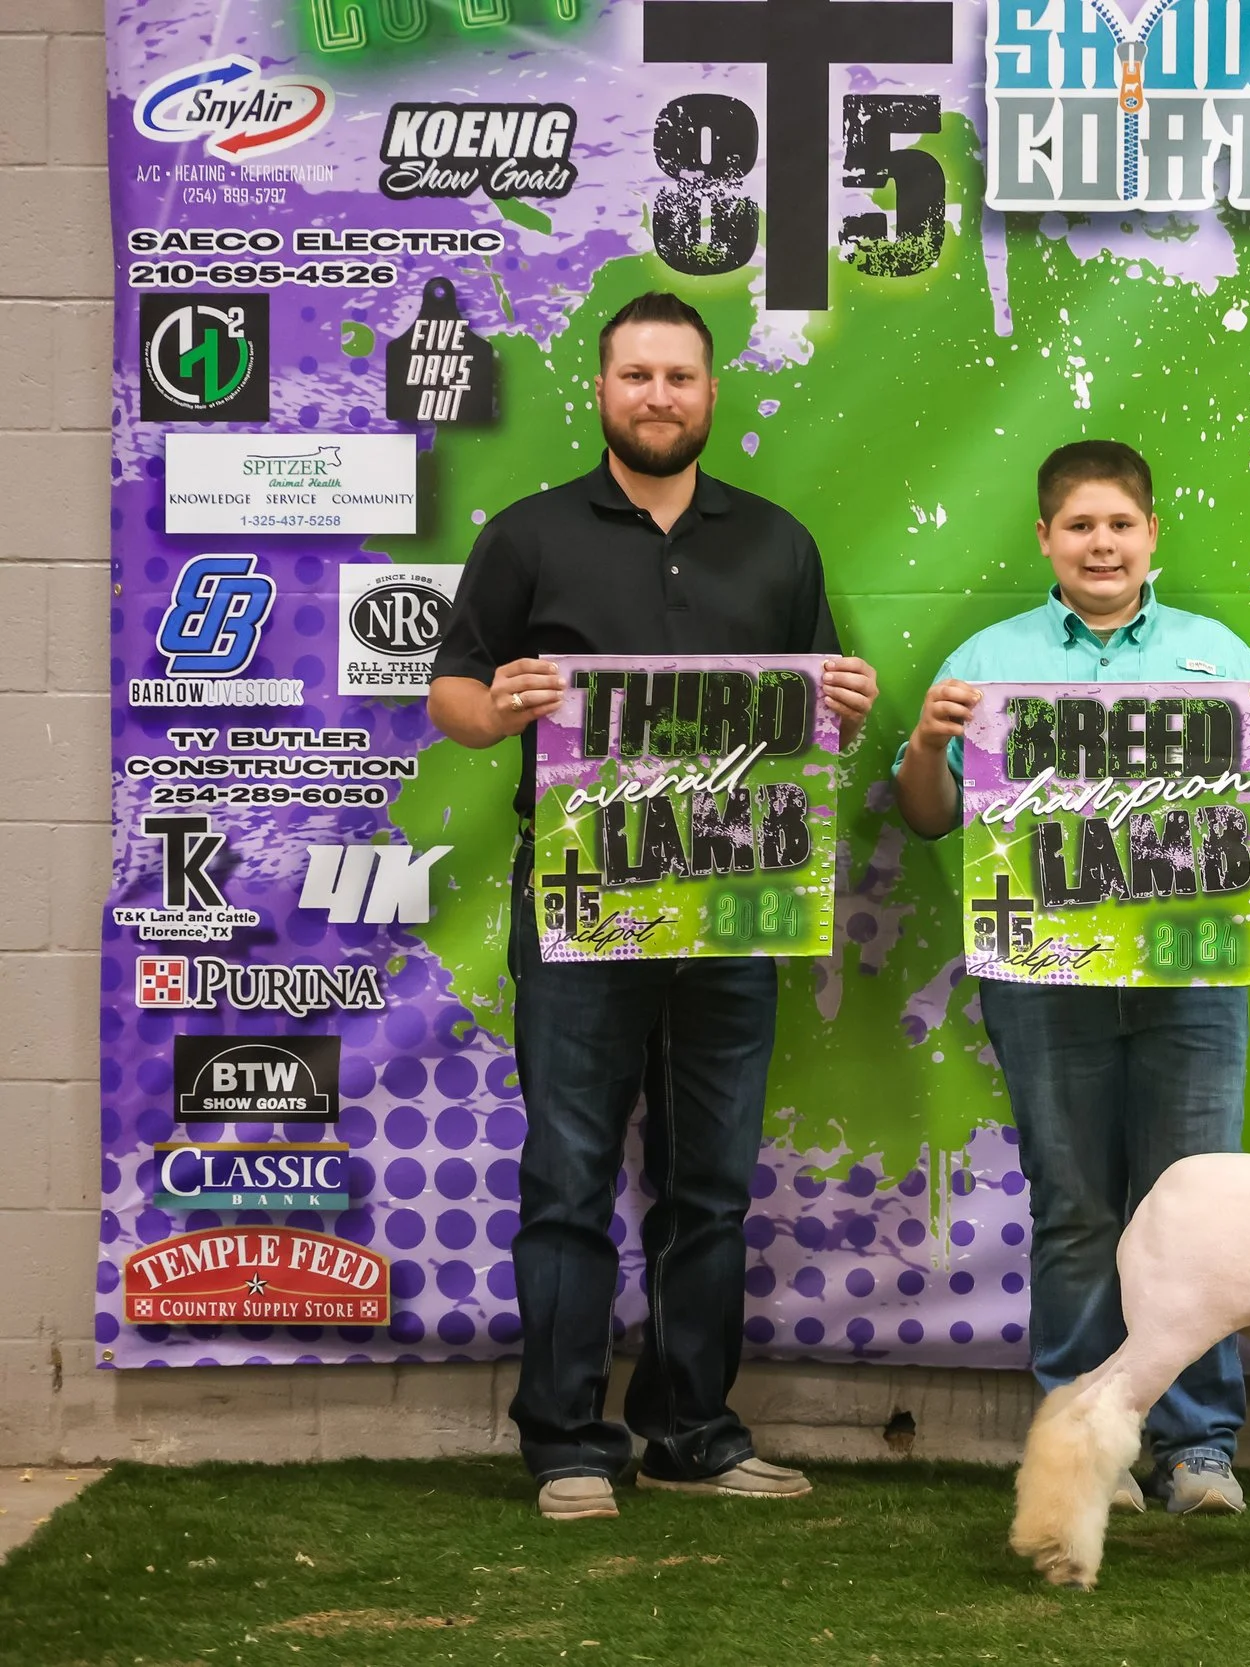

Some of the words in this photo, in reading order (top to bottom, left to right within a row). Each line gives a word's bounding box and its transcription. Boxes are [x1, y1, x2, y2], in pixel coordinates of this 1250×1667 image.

[186, 88, 292, 129] SnyAir
[387, 110, 571, 158] KOENIG
[136, 164, 161, 182] A/C
[175, 164, 226, 182] HEATING
[240, 164, 333, 182] REFRIGERATION
[385, 161, 479, 192] Show
[490, 160, 569, 192] Goats
[182, 187, 217, 204] (254)
[223, 187, 286, 204] 899-5797
[131, 232, 280, 252] SAECO
[297, 232, 502, 252] ELECTRIC
[131, 265, 394, 285] 210-695-4526
[411, 319, 469, 351] FIVE
[405, 355, 473, 387] DAYS
[416, 386, 471, 421] OUT
[243, 459, 328, 476] SPITZER
[268, 477, 304, 488] Animal
[307, 477, 342, 488] Health
[169, 493, 251, 505] KNOWLEDGE
[266, 493, 317, 505] SERVICE
[332, 493, 415, 505] COMMUNITY
[240, 515, 341, 527] 1-325-437-5258
[375, 573, 406, 584] SINCE
[366, 591, 439, 647] NRS
[347, 662, 382, 672] ALL
[388, 662, 435, 672] THIN
[347, 673, 432, 685] WESTE
[575, 670, 808, 757] THIRD
[171, 731, 217, 748] TY
[231, 732, 367, 748] BUTLER
[1007, 698, 1233, 780] BREED
[127, 759, 415, 776] CONSTRUCTION
[566, 741, 767, 813] overall
[154, 787, 385, 804] 254-289-6050
[602, 783, 811, 887] LAMB
[115, 911, 146, 923] T&K
[150, 911, 184, 923] Land
[188, 911, 213, 923] and
[216, 911, 256, 923] Cattle
[718, 890, 798, 941] 2024
[143, 926, 208, 940] Florence,
[211, 927, 229, 938] TX
[1156, 919, 1238, 971] 2024
[196, 961, 382, 1016] PURINA
[213, 1062, 298, 1093] BTW
[203, 1097, 252, 1110] SHOW
[256, 1097, 307, 1110] GOATS
[161, 1147, 341, 1197] CLASSIC
[232, 1194, 321, 1206] BANK
[133, 1234, 281, 1291] TEMPLE
[289, 1236, 380, 1291] FEED
[159, 1299, 236, 1318] COUNTRY
[243, 1299, 299, 1318] SUPPLY
[305, 1300, 354, 1318] STORE
